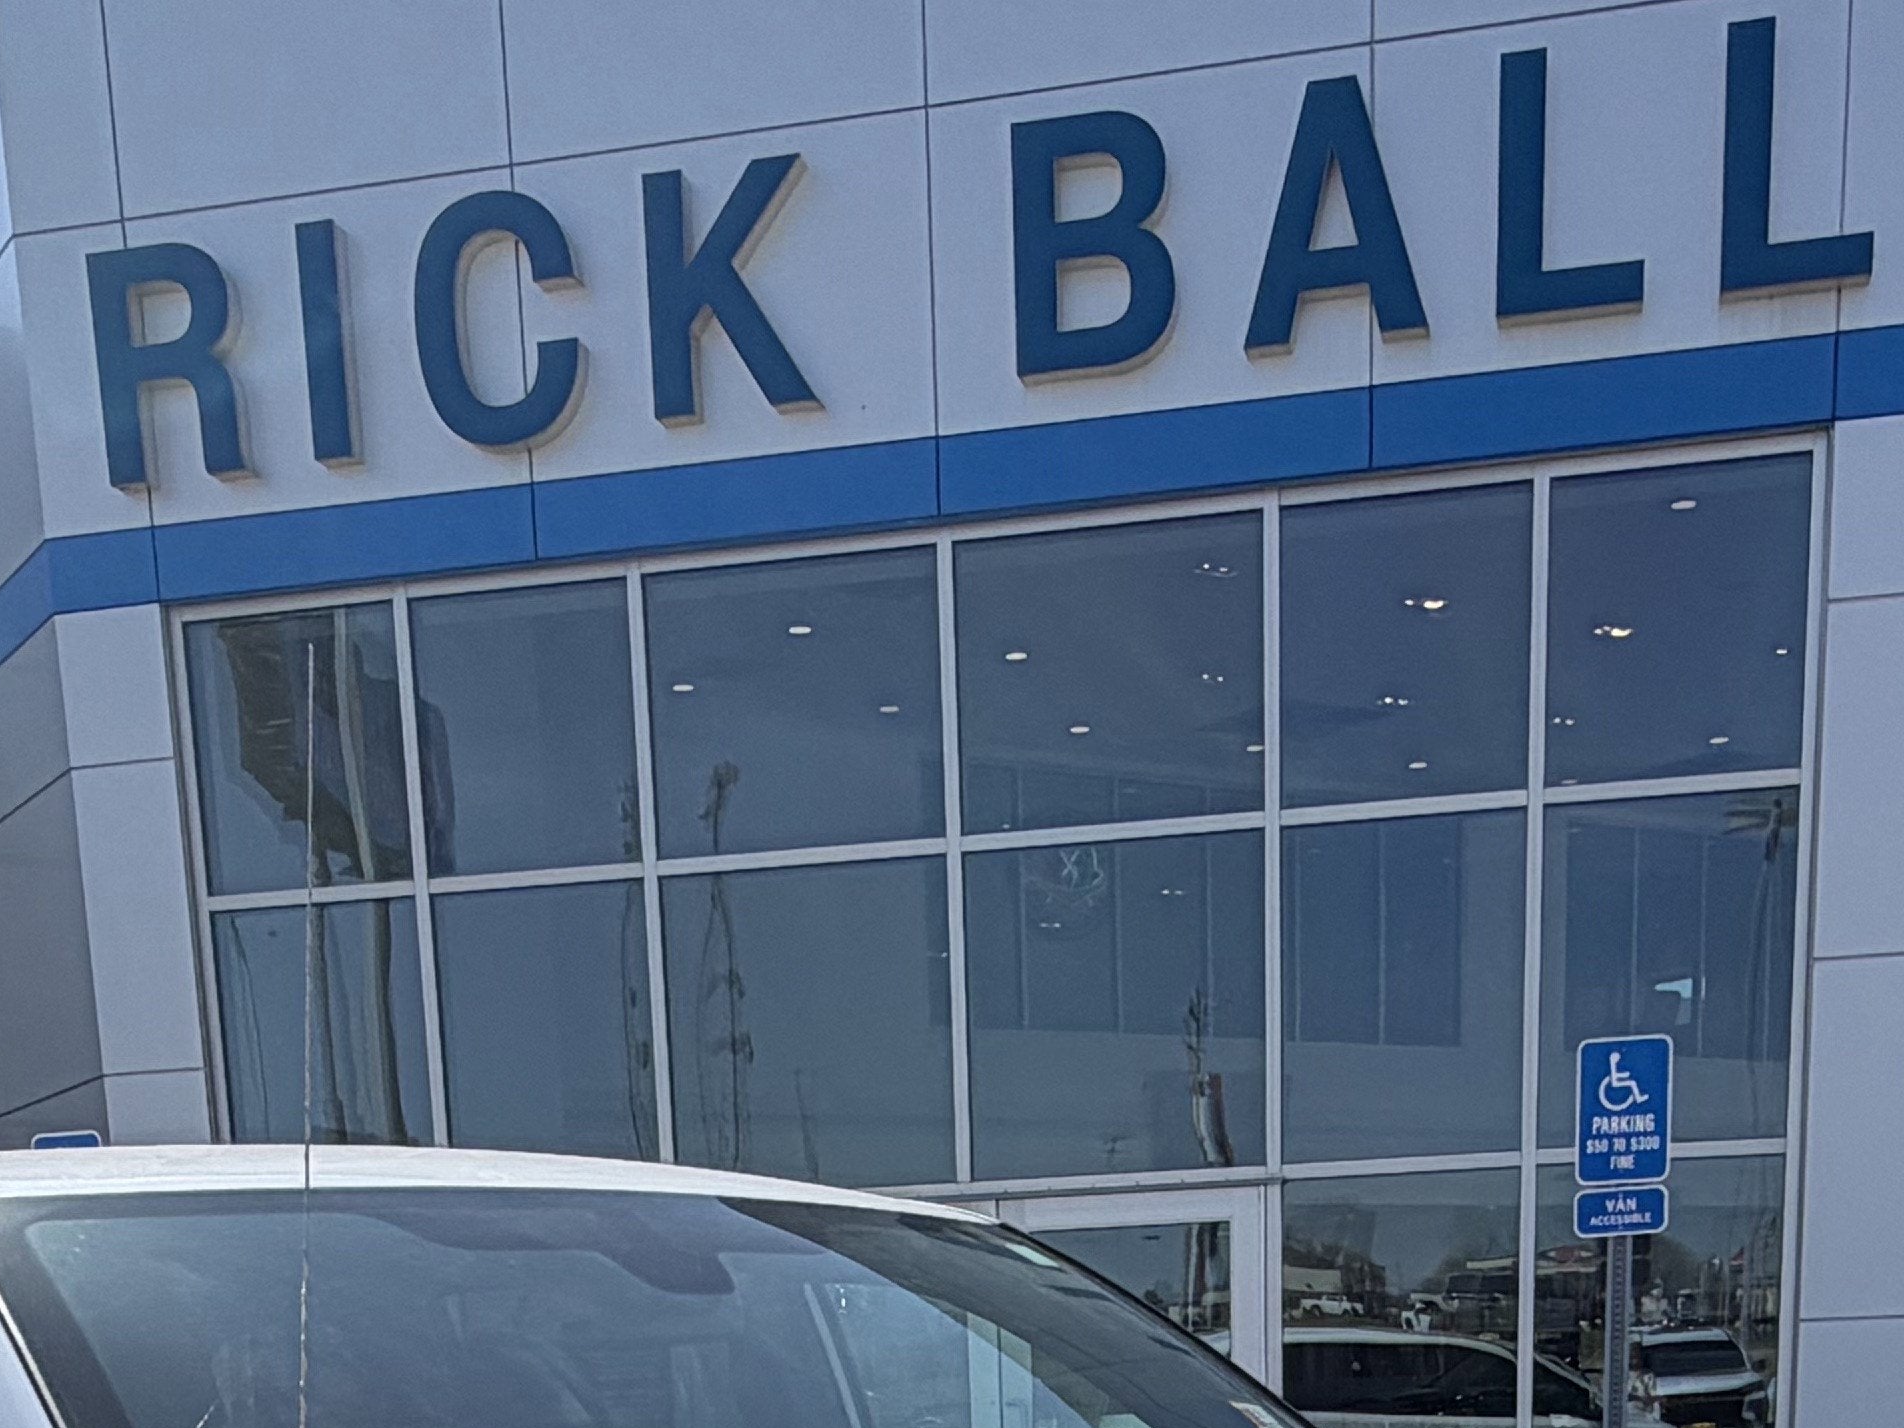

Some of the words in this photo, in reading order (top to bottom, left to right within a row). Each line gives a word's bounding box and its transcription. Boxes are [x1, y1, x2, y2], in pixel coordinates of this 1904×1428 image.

[84, 152, 823, 493] RICK
[1011, 15, 1875, 387] BALL
[1592, 1113, 1656, 1135] PARKING
[1586, 1138, 1609, 1154] $50
[1612, 1137, 1627, 1152] TO
[1630, 1135, 1661, 1152] $300
[1610, 1154, 1636, 1170] FINE
[1605, 1197, 1637, 1213] VAN
[1590, 1212, 1652, 1226] ACCESSIBLE
